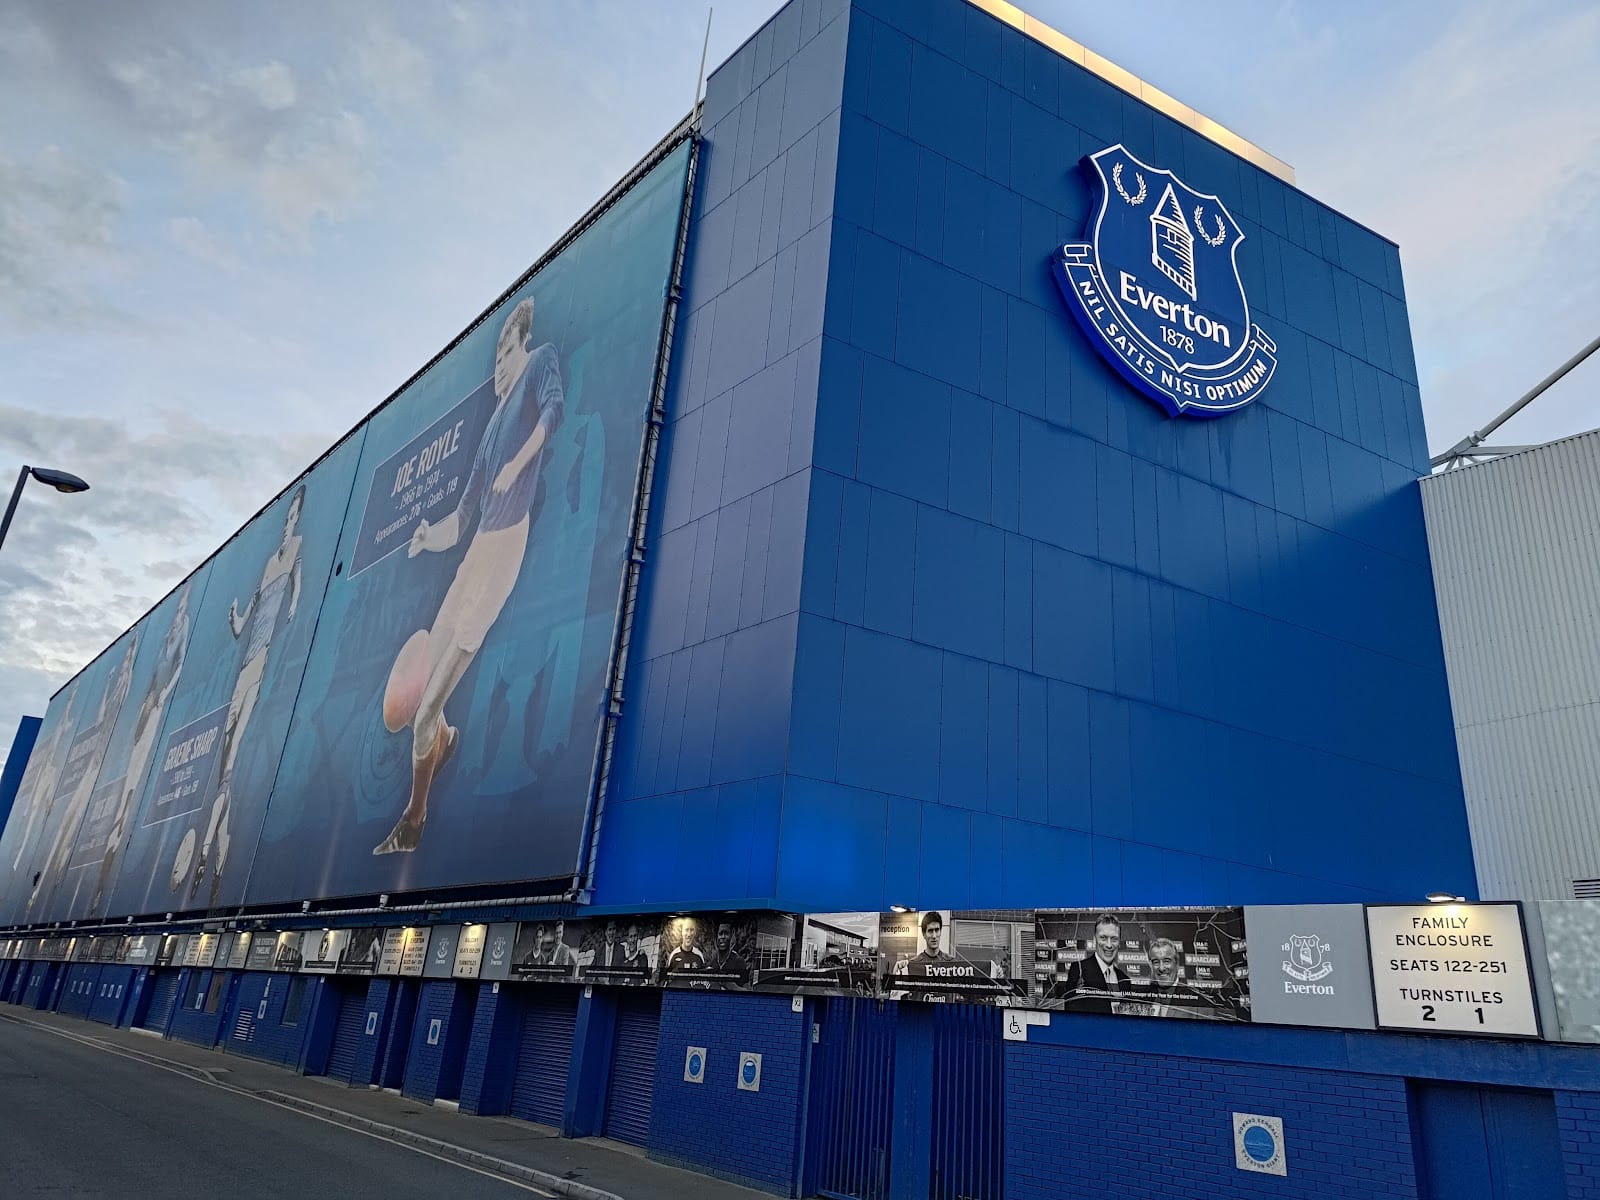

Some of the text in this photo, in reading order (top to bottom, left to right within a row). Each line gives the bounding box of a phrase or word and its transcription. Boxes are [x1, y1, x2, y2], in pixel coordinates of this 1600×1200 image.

[1119, 270, 1230, 348] Everton
[1079, 280, 1268, 401] NIL SATIS NISI OPTIMUM
[1159, 325, 1195, 355] 1878
[391, 419, 464, 498] JOE ROYLE
[881, 925, 910, 934] reception
[1412, 917, 1469, 929] FAMILY
[1281, 943, 1331, 953] 18 78
[1395, 935, 1493, 947] ENCLOSURE
[925, 964, 975, 977] Everton
[1390, 959, 1507, 974] SEATS 122-251
[1284, 981, 1335, 995] Everton
[1400, 988, 1503, 1004] TURNSTILES
[1421, 1005, 1485, 1025] 2 1
